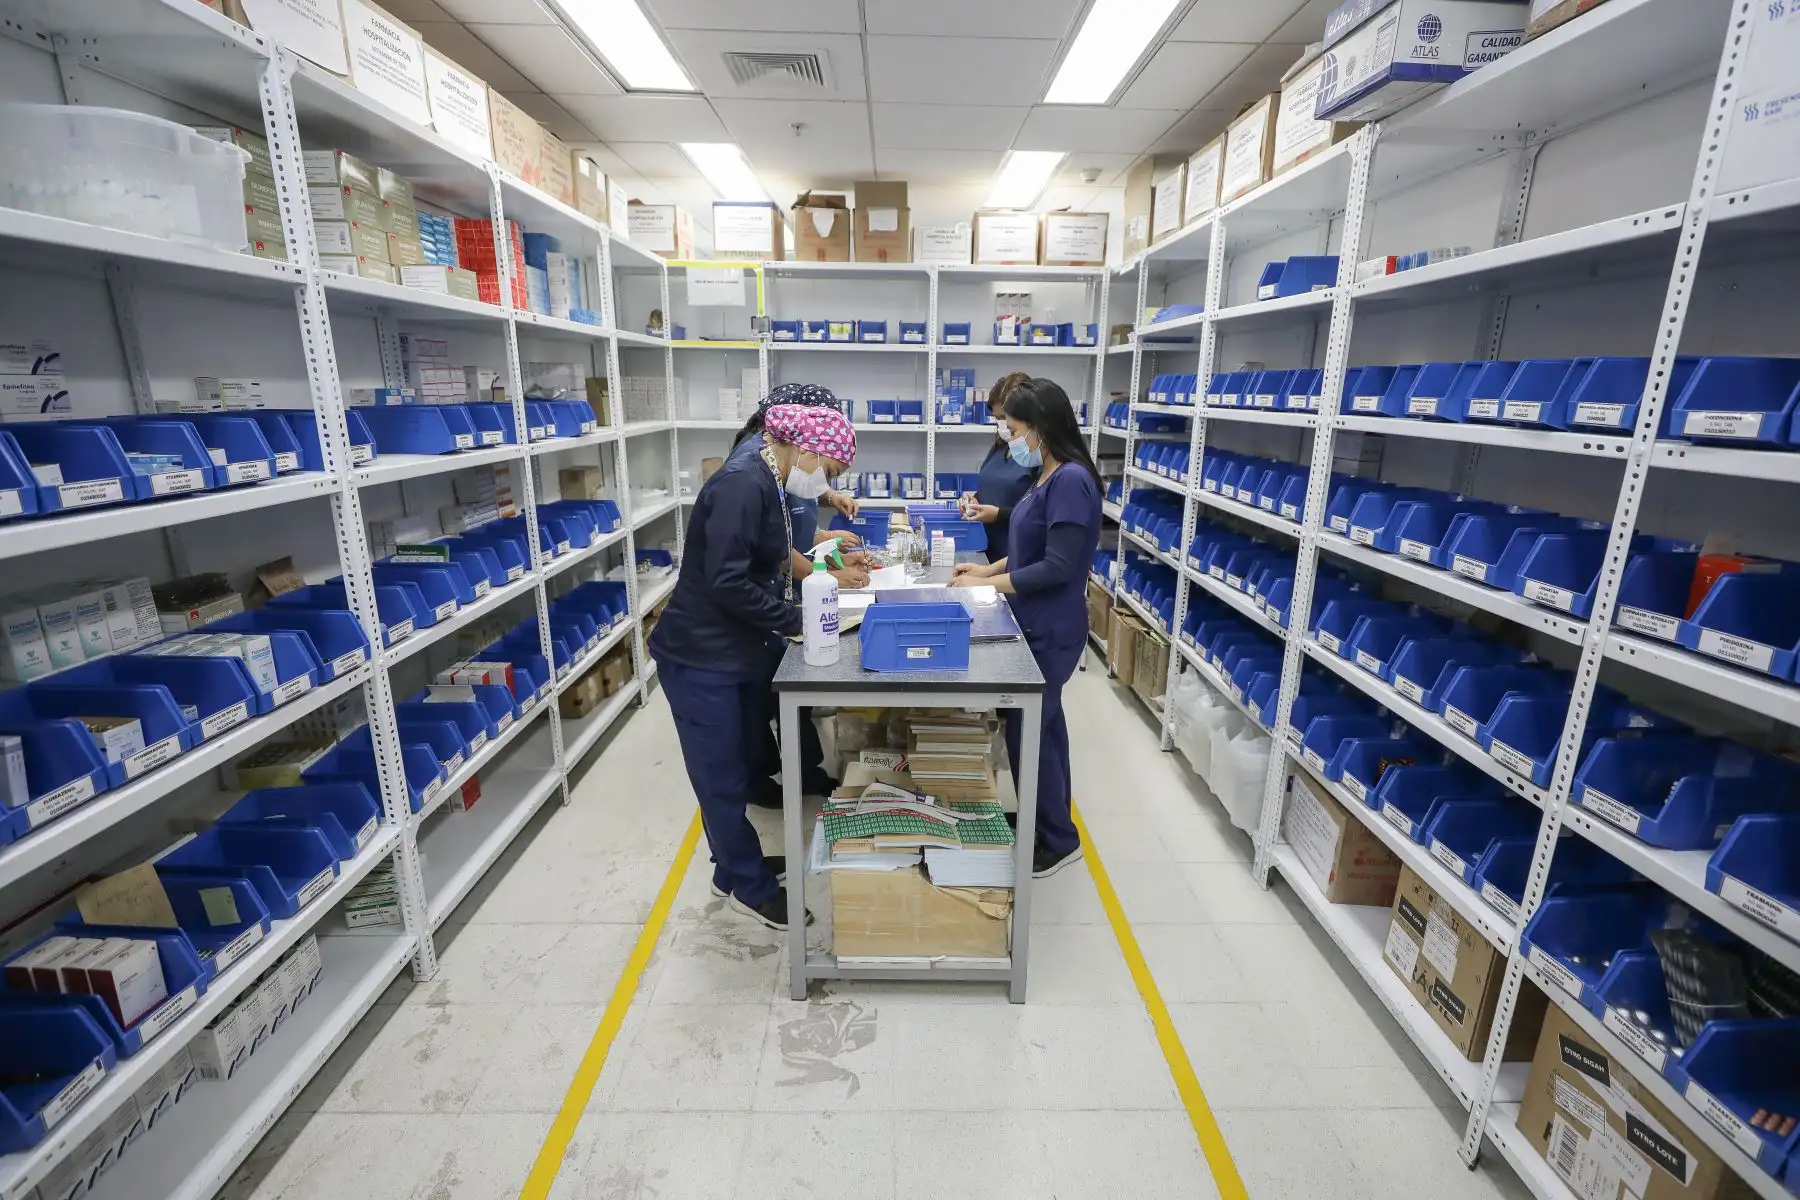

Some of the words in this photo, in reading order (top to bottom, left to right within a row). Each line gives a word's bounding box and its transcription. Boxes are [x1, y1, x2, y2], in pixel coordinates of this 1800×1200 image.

[1481, 37, 1521, 48] CALIDAD
[1411, 46, 1439, 57] ATLAS
[1564, 1045, 1581, 1061] OTRO
[1633, 1126, 1654, 1149] OTRO
[1656, 1143, 1677, 1167] LOTE
